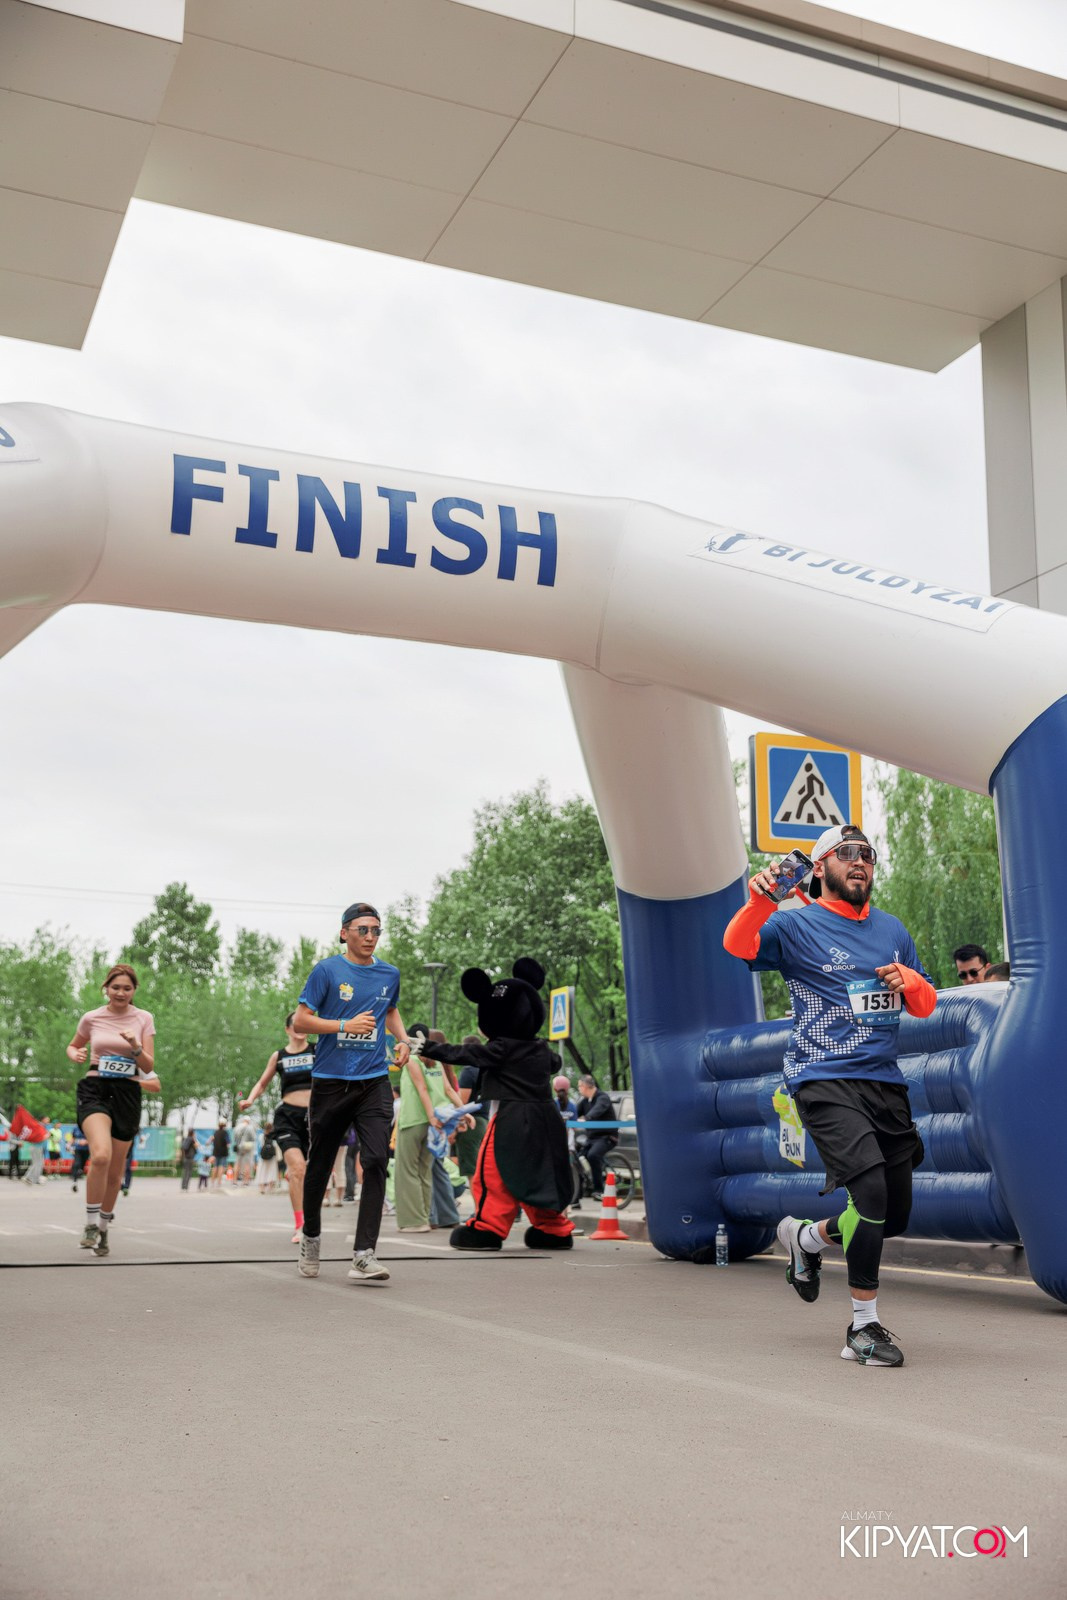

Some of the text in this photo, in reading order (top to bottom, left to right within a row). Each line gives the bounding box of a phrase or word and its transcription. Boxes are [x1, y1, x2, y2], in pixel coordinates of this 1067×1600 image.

[171, 454, 558, 587] FINISH
[763, 544, 1005, 613] BI JULDYZAI
[861, 993, 895, 1011] 1531
[104, 1061, 132, 1072] 1627
[289, 1057, 308, 1066] 1156
[782, 1129, 789, 1142] BI
[785, 1143, 801, 1157] RUN
